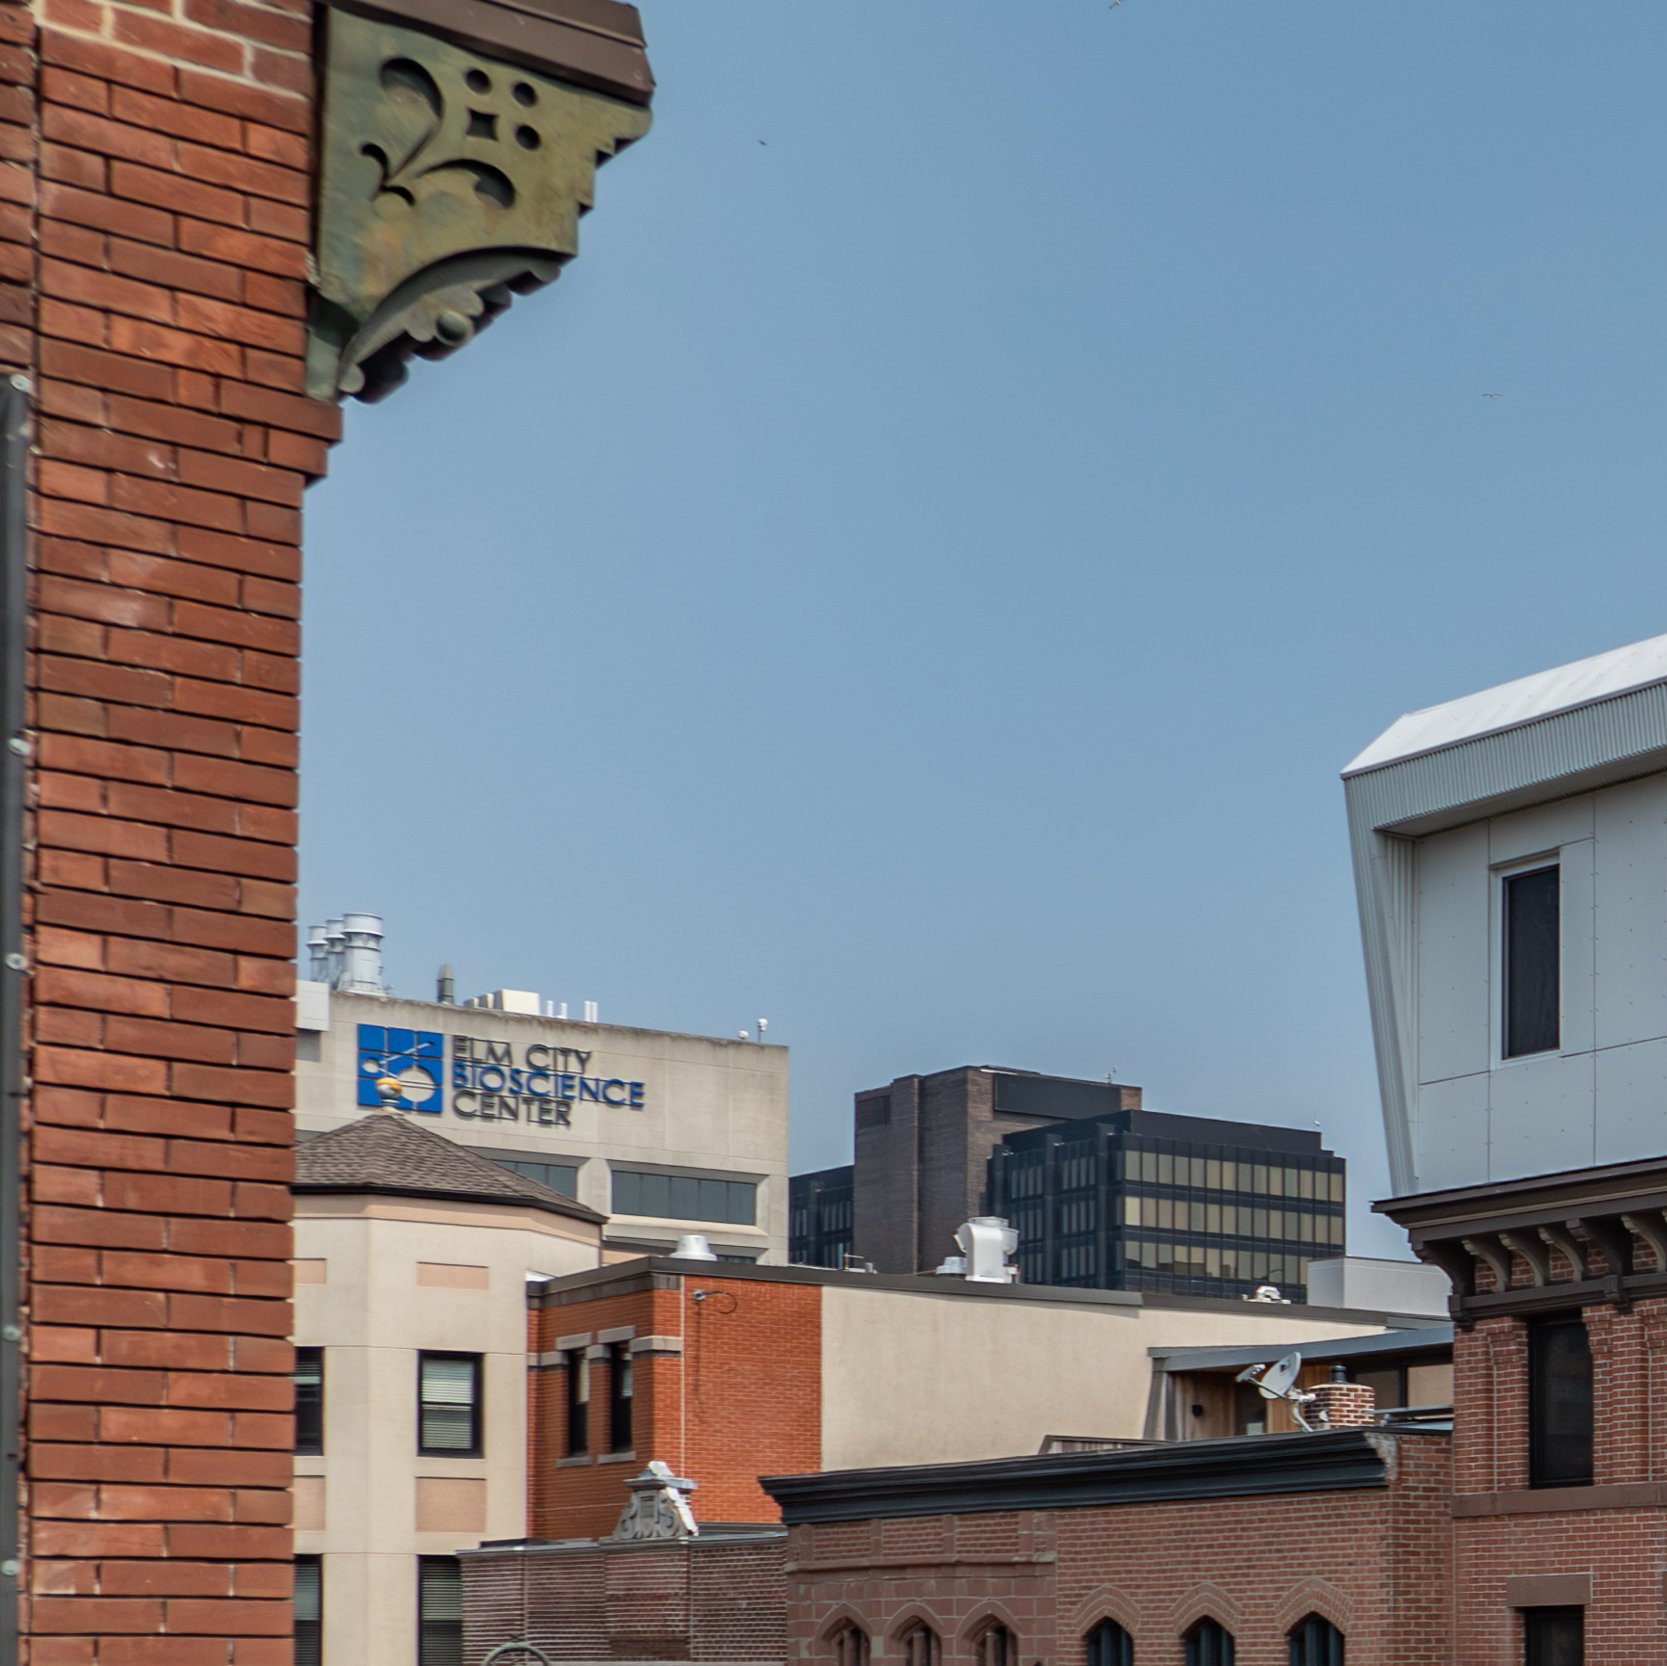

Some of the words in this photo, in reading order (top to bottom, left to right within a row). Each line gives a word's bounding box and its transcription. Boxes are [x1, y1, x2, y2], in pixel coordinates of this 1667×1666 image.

[453, 1035, 513, 1067] ELM
[526, 1044, 592, 1074] CITY
[453, 1063, 645, 1108] BIOSCIENCE
[453, 1089, 572, 1126] CENTER
